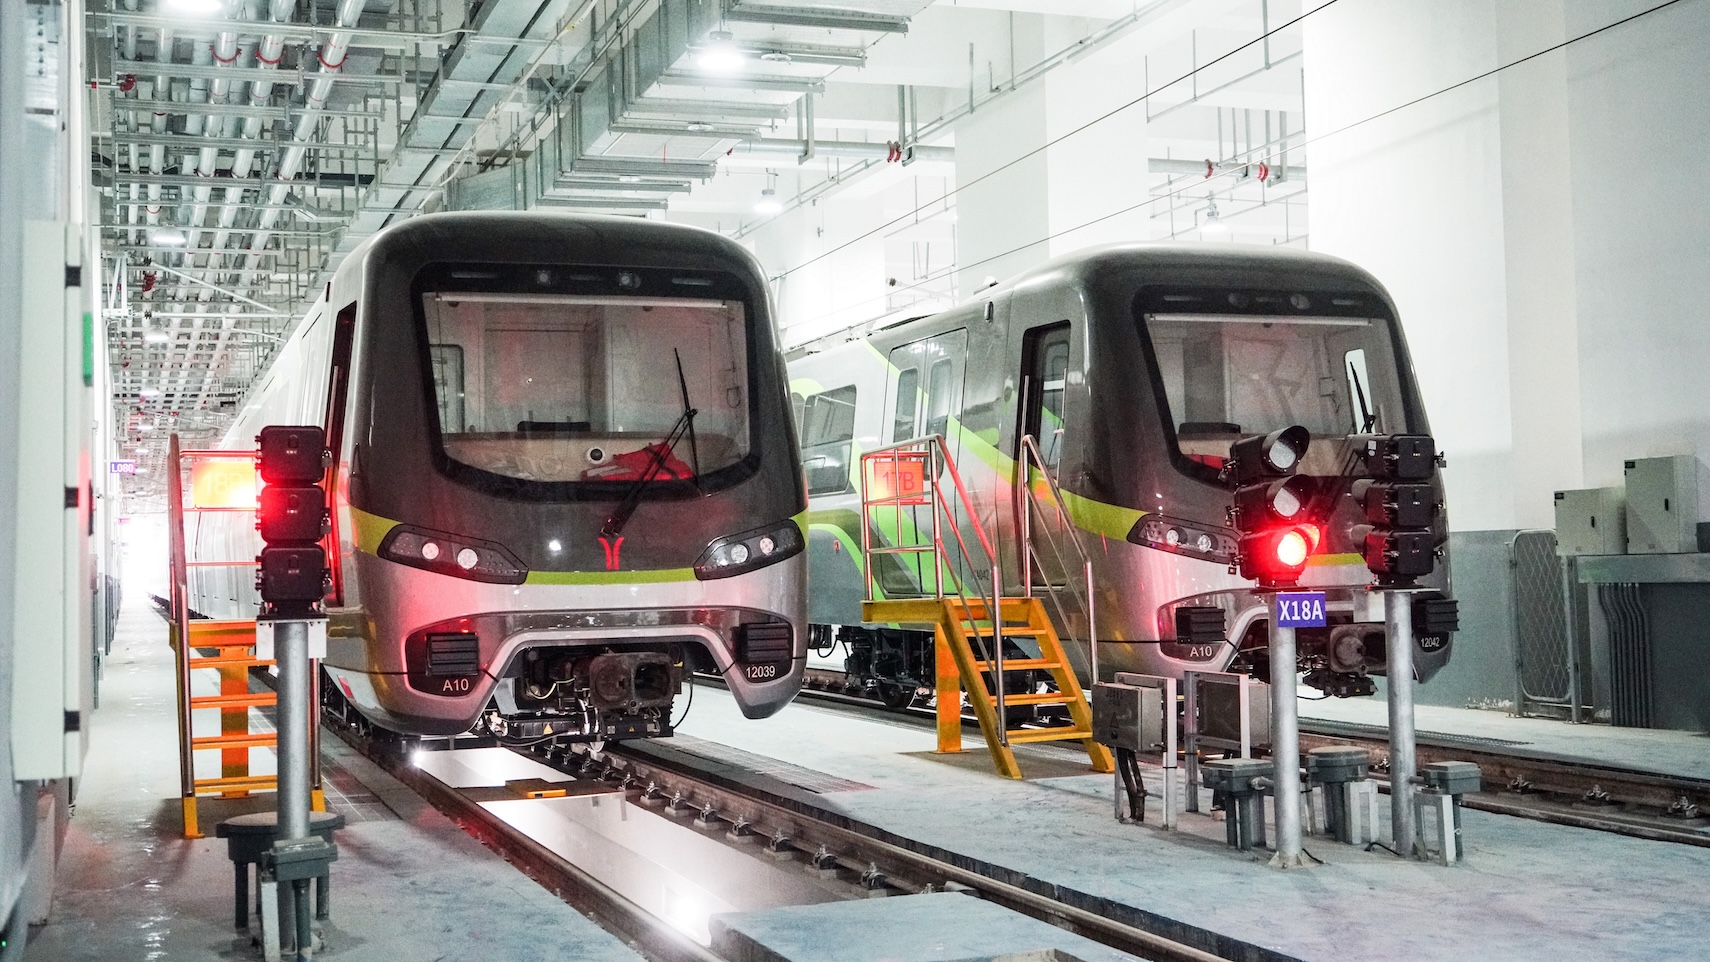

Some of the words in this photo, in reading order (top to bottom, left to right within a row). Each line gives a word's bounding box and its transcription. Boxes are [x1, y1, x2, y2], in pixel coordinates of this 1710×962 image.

[883, 471, 915, 491] 17B
[1280, 600, 1324, 621] X18A
[1421, 637, 1440, 648] 12042
[1190, 646, 1213, 657] A10
[746, 665, 776, 678] 12039
[442, 678, 469, 691] A10
